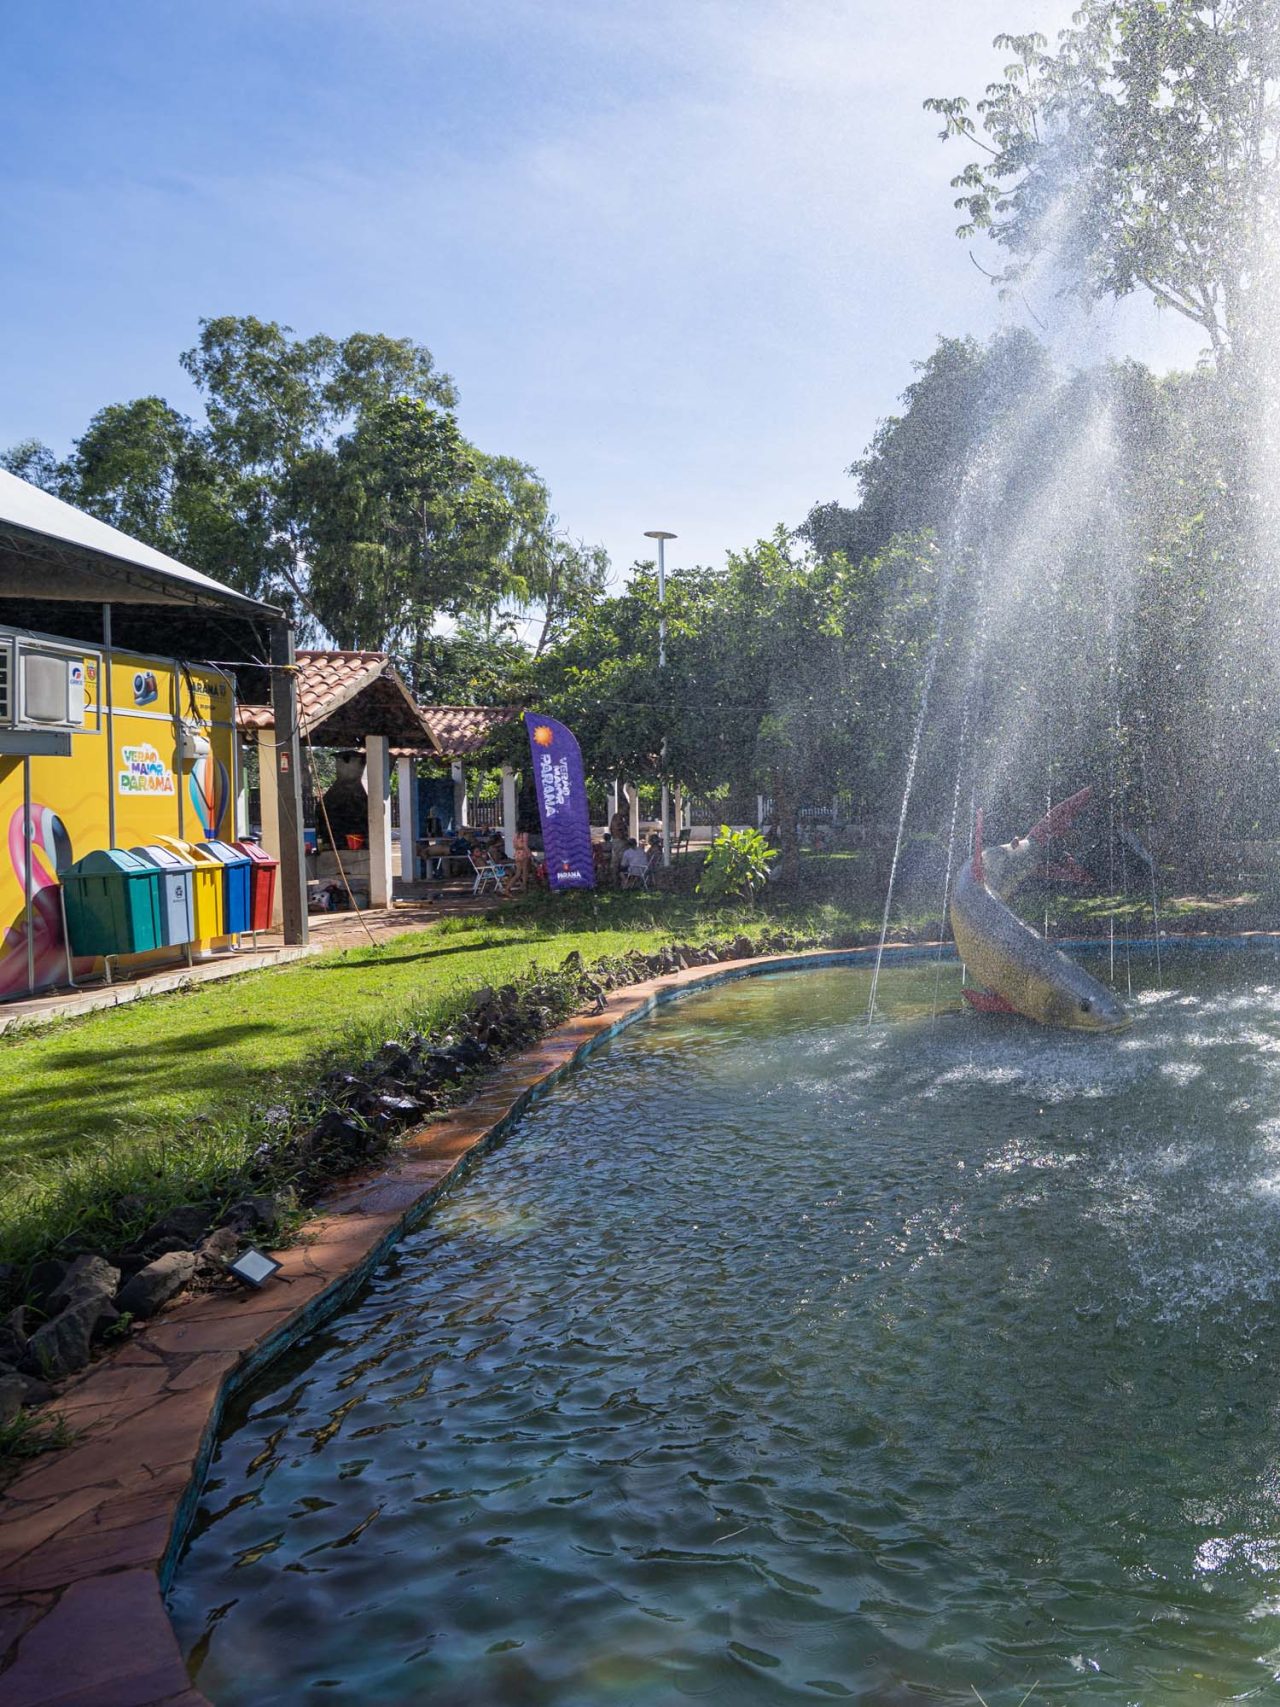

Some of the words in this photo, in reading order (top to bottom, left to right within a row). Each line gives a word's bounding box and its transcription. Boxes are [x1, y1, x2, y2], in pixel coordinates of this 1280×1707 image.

[121, 773, 173, 791] PARANÁ
[131, 762, 163, 776] MAIOR
[540, 754, 559, 817] PARANÁ
[553, 765, 565, 804] MAIOR
[560, 757, 572, 796] VERÃO
